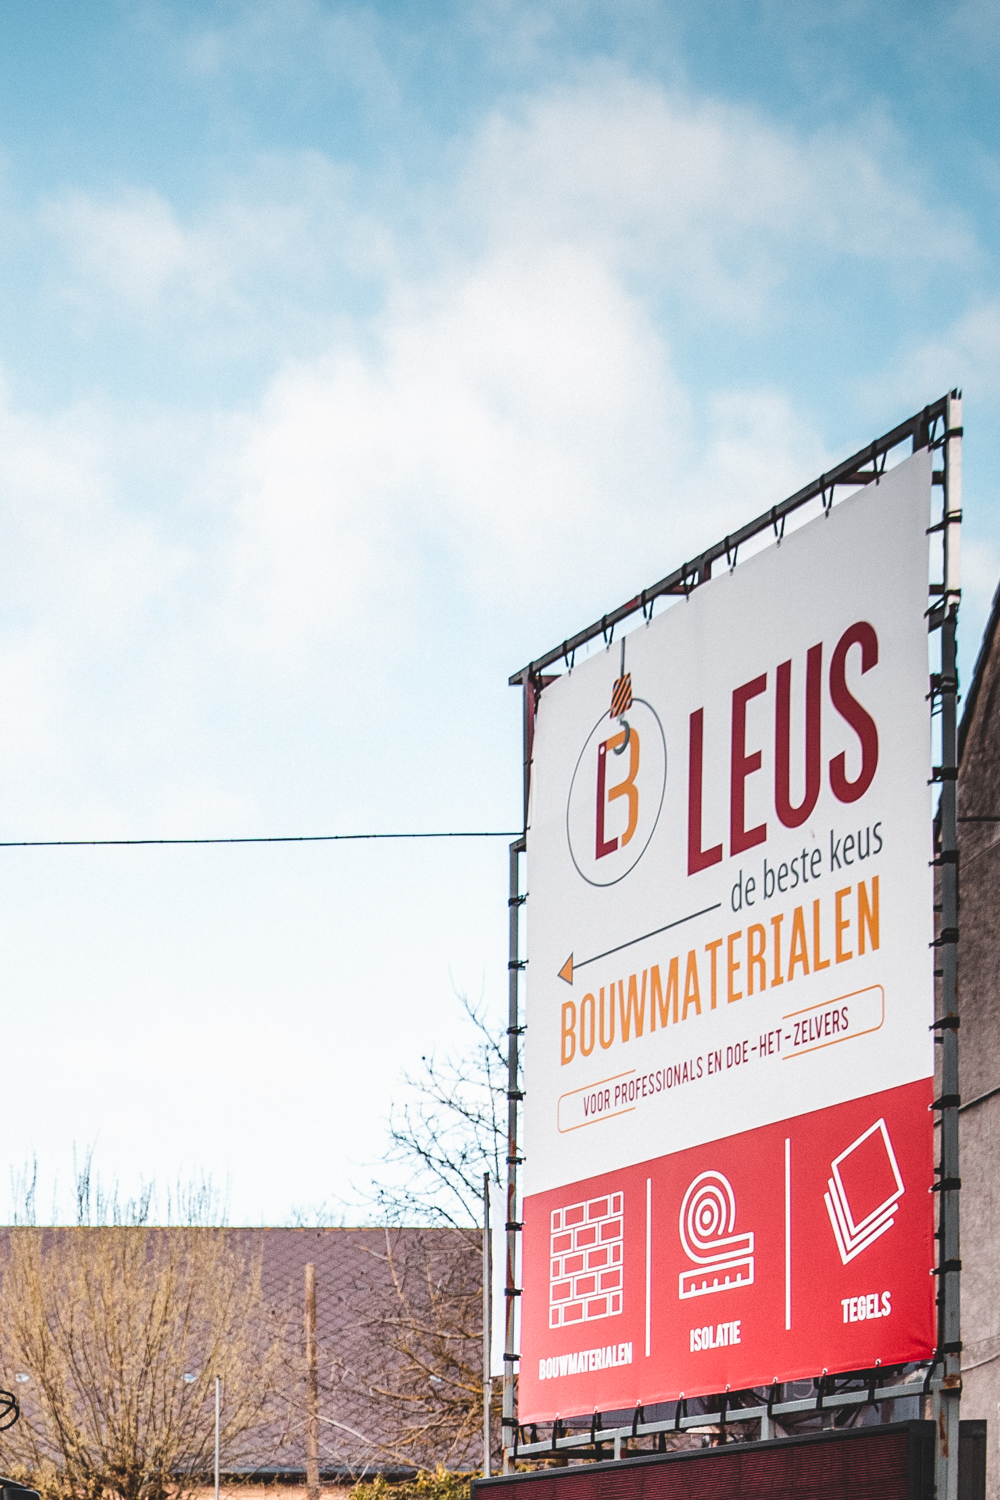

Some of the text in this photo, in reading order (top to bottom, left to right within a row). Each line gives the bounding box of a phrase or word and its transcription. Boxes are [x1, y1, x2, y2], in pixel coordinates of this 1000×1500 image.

[687, 620, 880, 877] LEUS
[731, 821, 884, 912] de beste keus
[561, 875, 880, 1066] BOUWMATERIALEN
[583, 1088, 611, 1117] VOOR
[614, 1056, 704, 1107] PROFESSIONALS
[707, 1050, 723, 1076] EN
[689, 1320, 742, 1352] ISOLATIE
[841, 1291, 892, 1323] TEGELS
[539, 1342, 633, 1380] BOUWMATERIALEN
